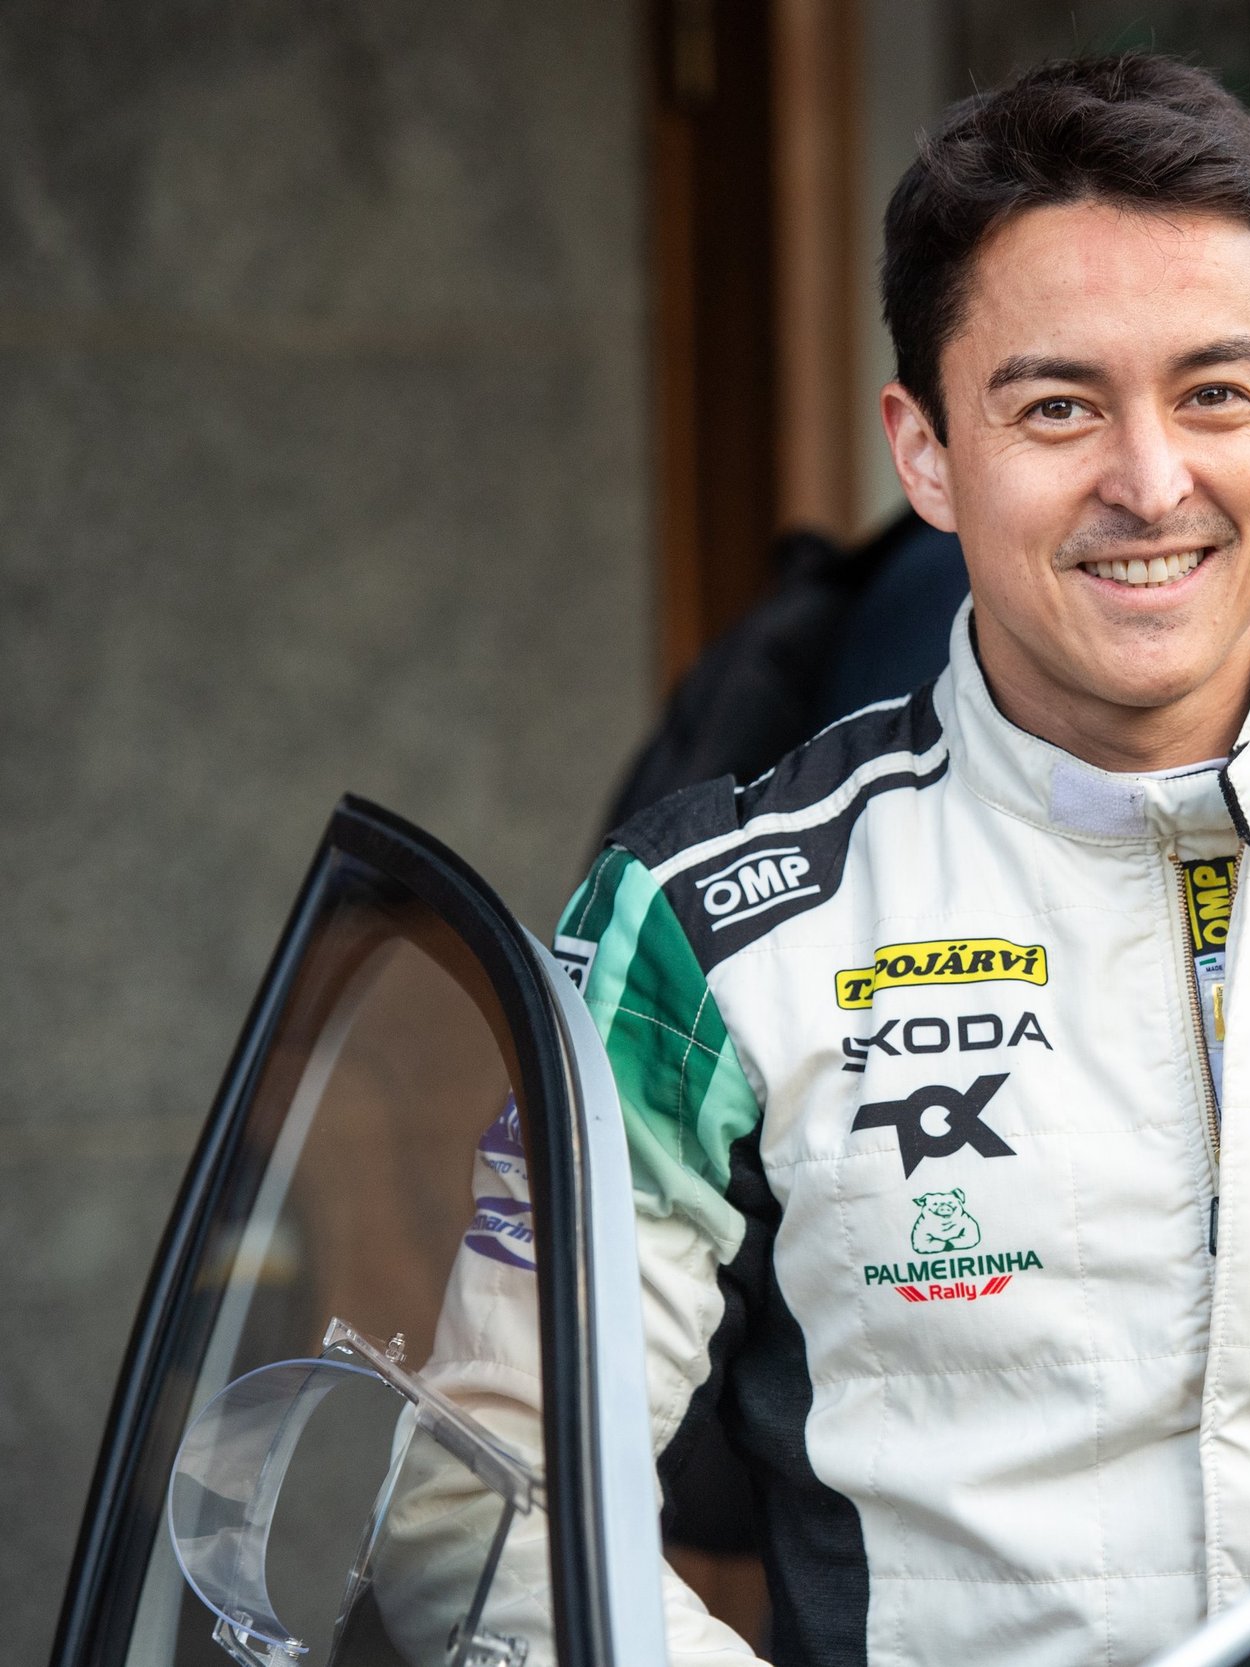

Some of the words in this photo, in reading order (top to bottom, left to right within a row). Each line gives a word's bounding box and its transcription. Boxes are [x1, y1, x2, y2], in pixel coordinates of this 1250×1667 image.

[703, 855, 810, 916] OMP
[1192, 865, 1231, 945] OMP
[864, 1250, 1043, 1285] PALMEIRINHA
[930, 1281, 977, 1302] Rally
